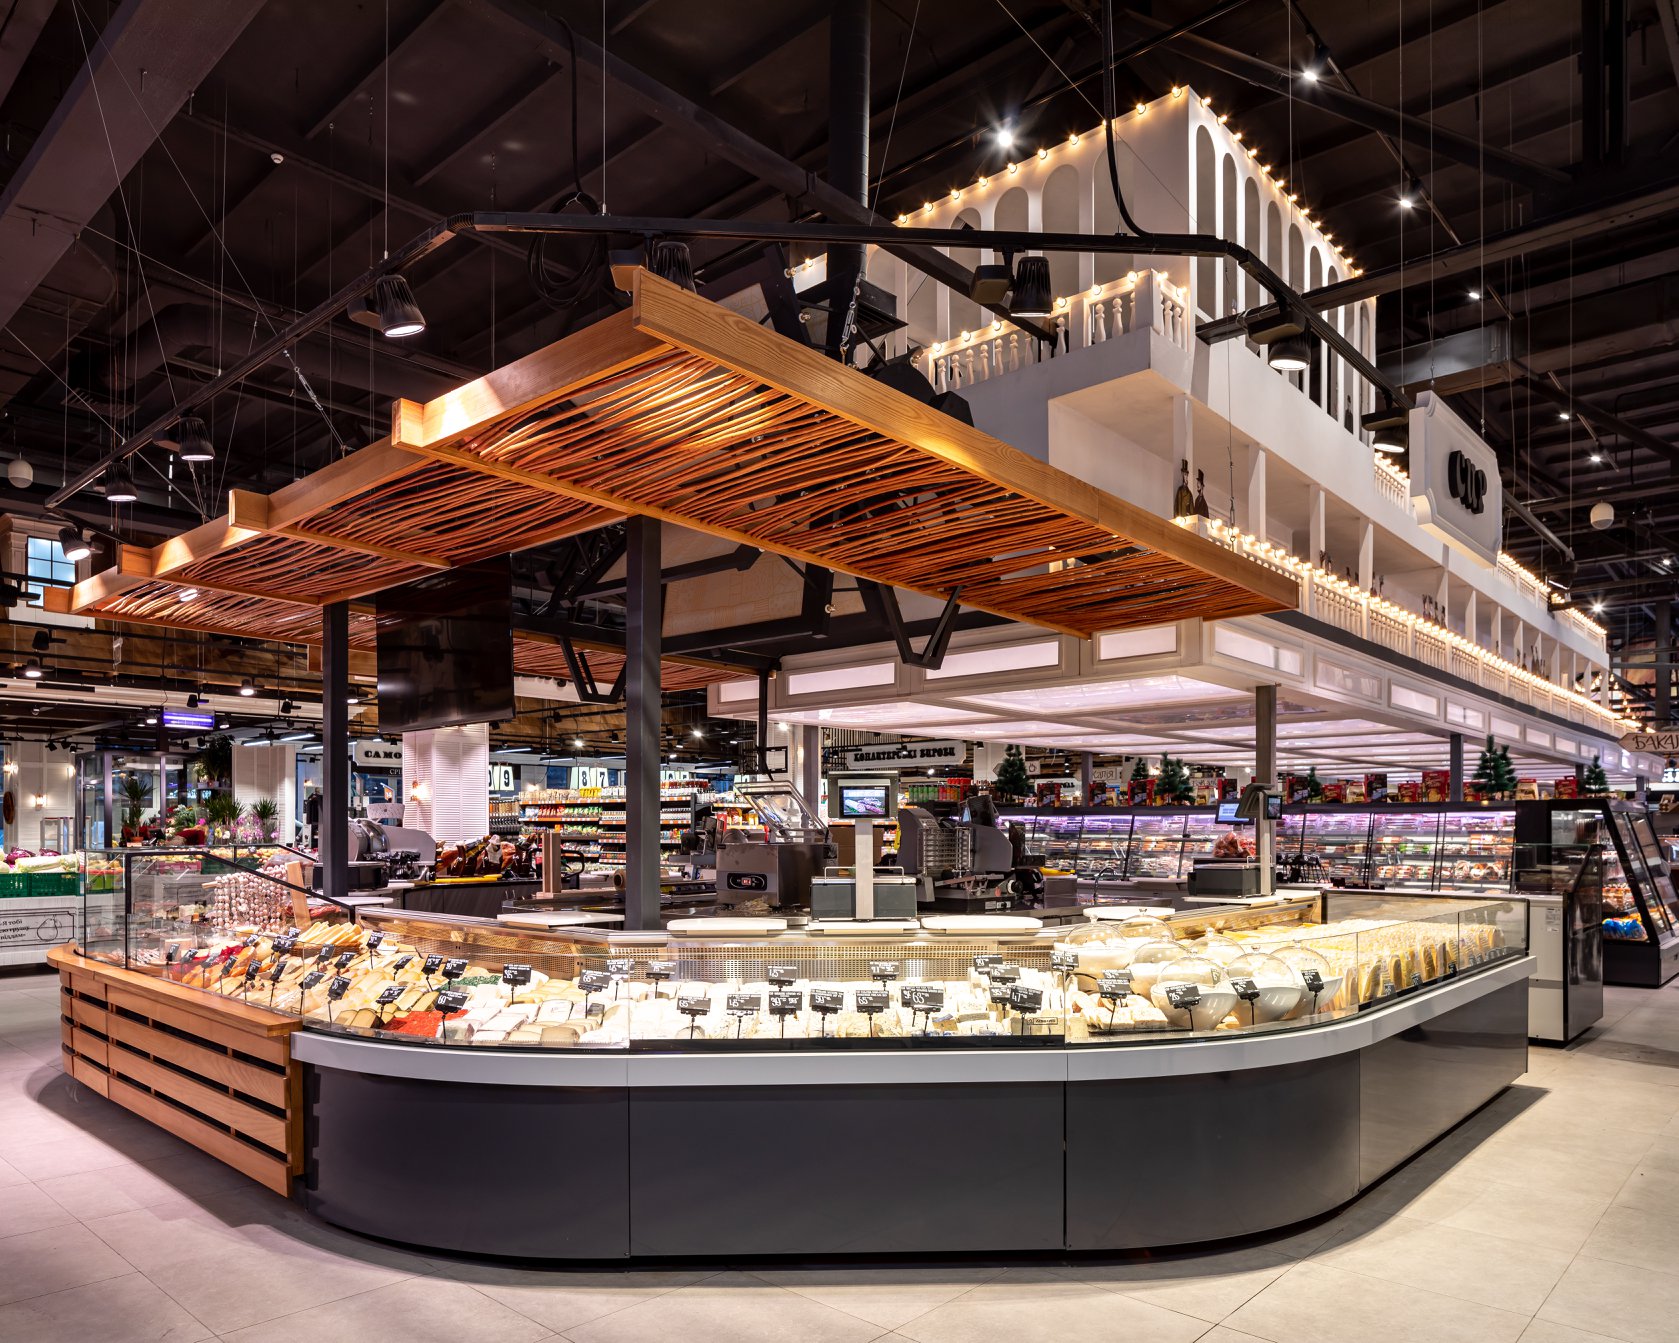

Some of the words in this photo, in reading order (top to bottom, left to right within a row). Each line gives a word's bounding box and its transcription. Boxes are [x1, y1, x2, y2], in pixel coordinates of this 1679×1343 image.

[503, 769, 510, 787] 9
[581, 770, 588, 787] 8
[599, 771, 606, 788] 7
